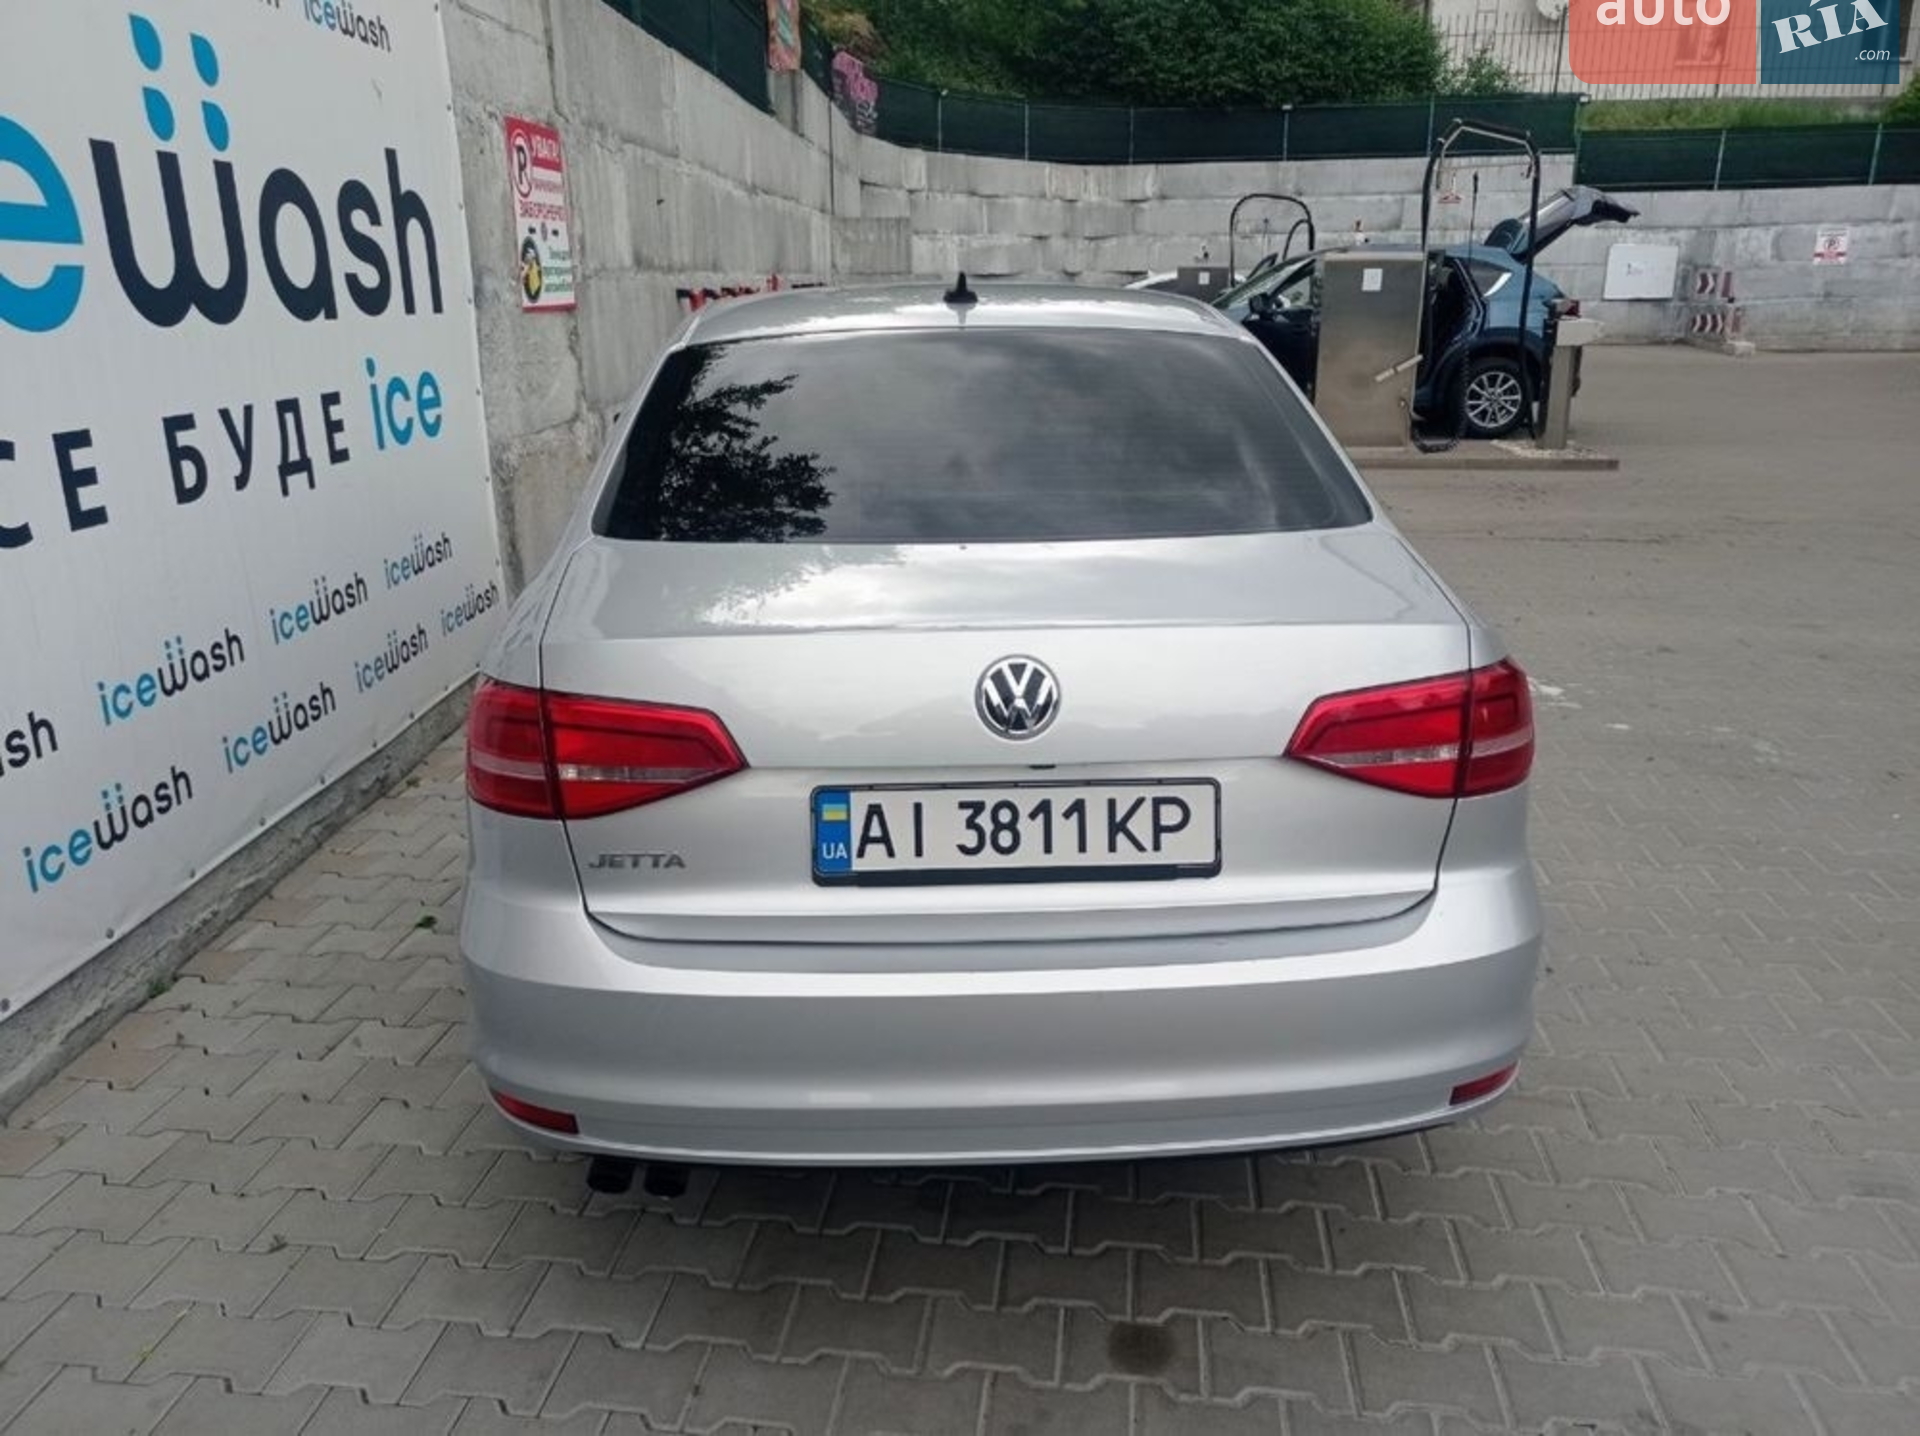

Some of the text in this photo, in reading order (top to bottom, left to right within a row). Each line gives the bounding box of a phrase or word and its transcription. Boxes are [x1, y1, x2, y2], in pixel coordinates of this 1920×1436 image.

[162, 391, 351, 505] БУДЕ
[365, 357, 443, 451] ice
[0, 711, 58, 777] sh
[822, 841, 848, 860] UA
[855, 801, 924, 859] AI
[588, 853, 687, 869] JETTA
